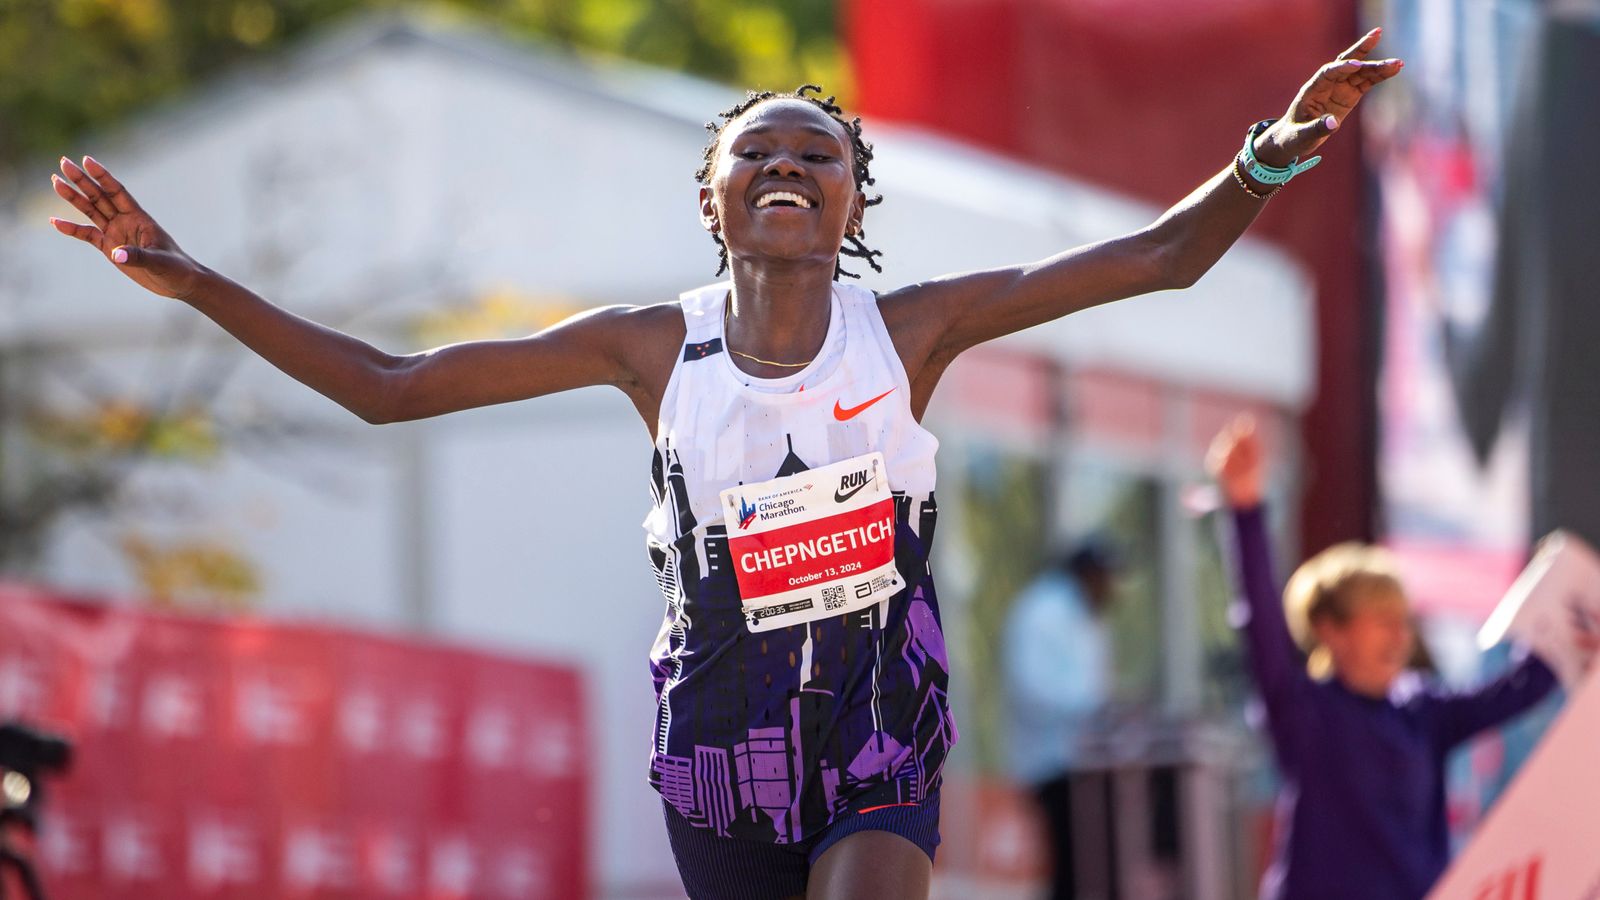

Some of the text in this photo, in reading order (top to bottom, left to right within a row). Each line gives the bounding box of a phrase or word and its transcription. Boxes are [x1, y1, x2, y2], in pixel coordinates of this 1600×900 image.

[840, 469, 868, 490] RUN
[759, 498, 794, 512] Chicago
[740, 517, 893, 574] CHEPNGETICH
[788, 561, 862, 586] October 13, 2024
